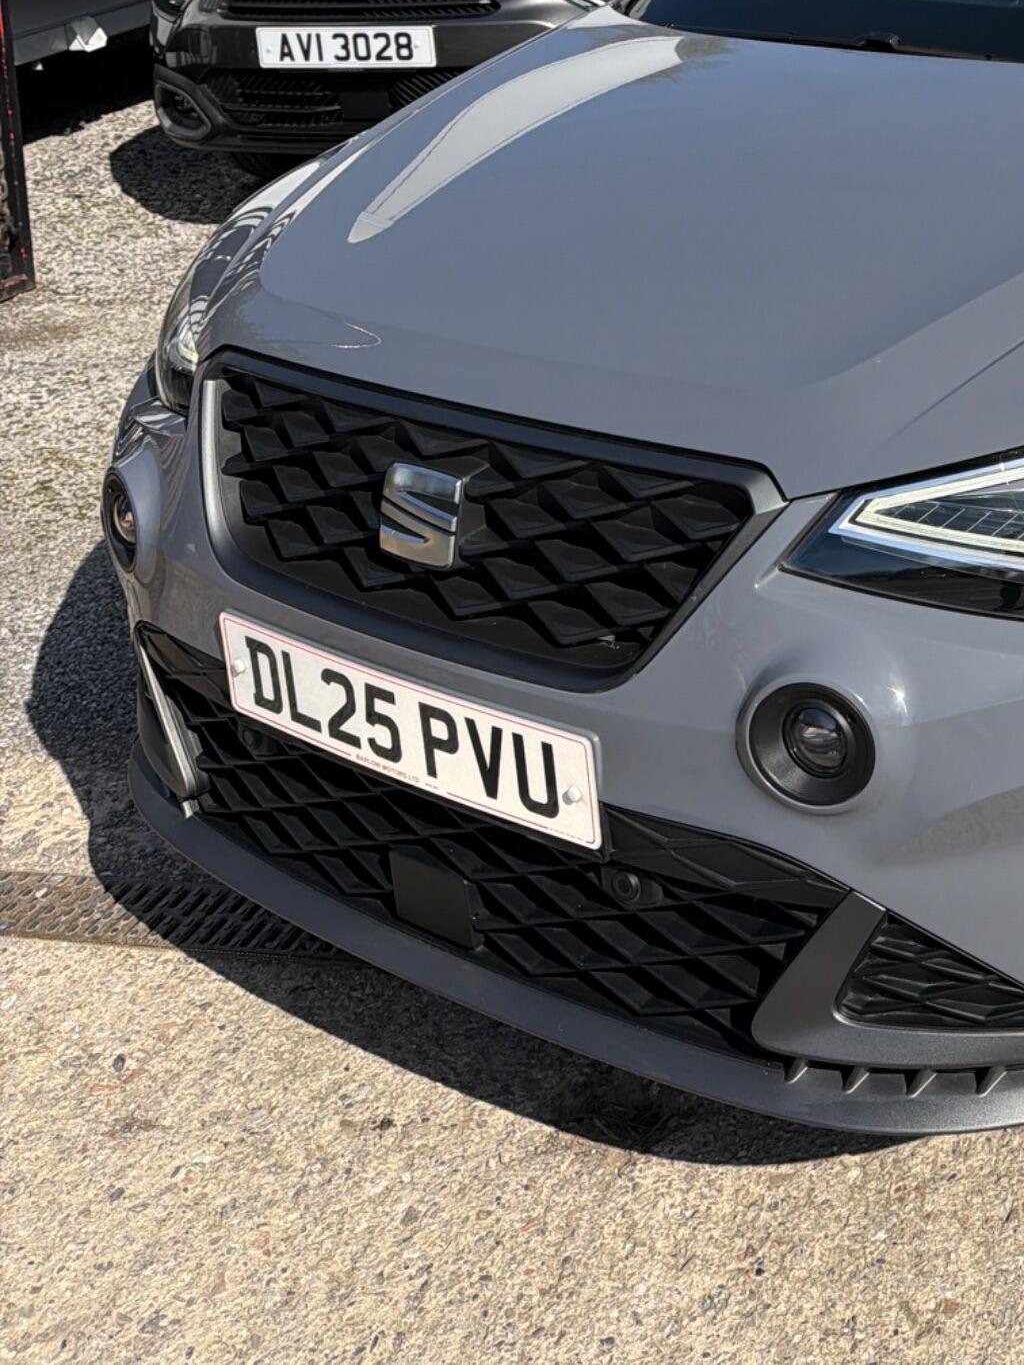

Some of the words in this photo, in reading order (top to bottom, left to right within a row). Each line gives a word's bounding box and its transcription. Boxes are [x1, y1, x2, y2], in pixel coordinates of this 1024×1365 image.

[331, 32, 413, 62] 3028
[244, 635, 402, 763] DL25
[418, 701, 560, 819] PVU
